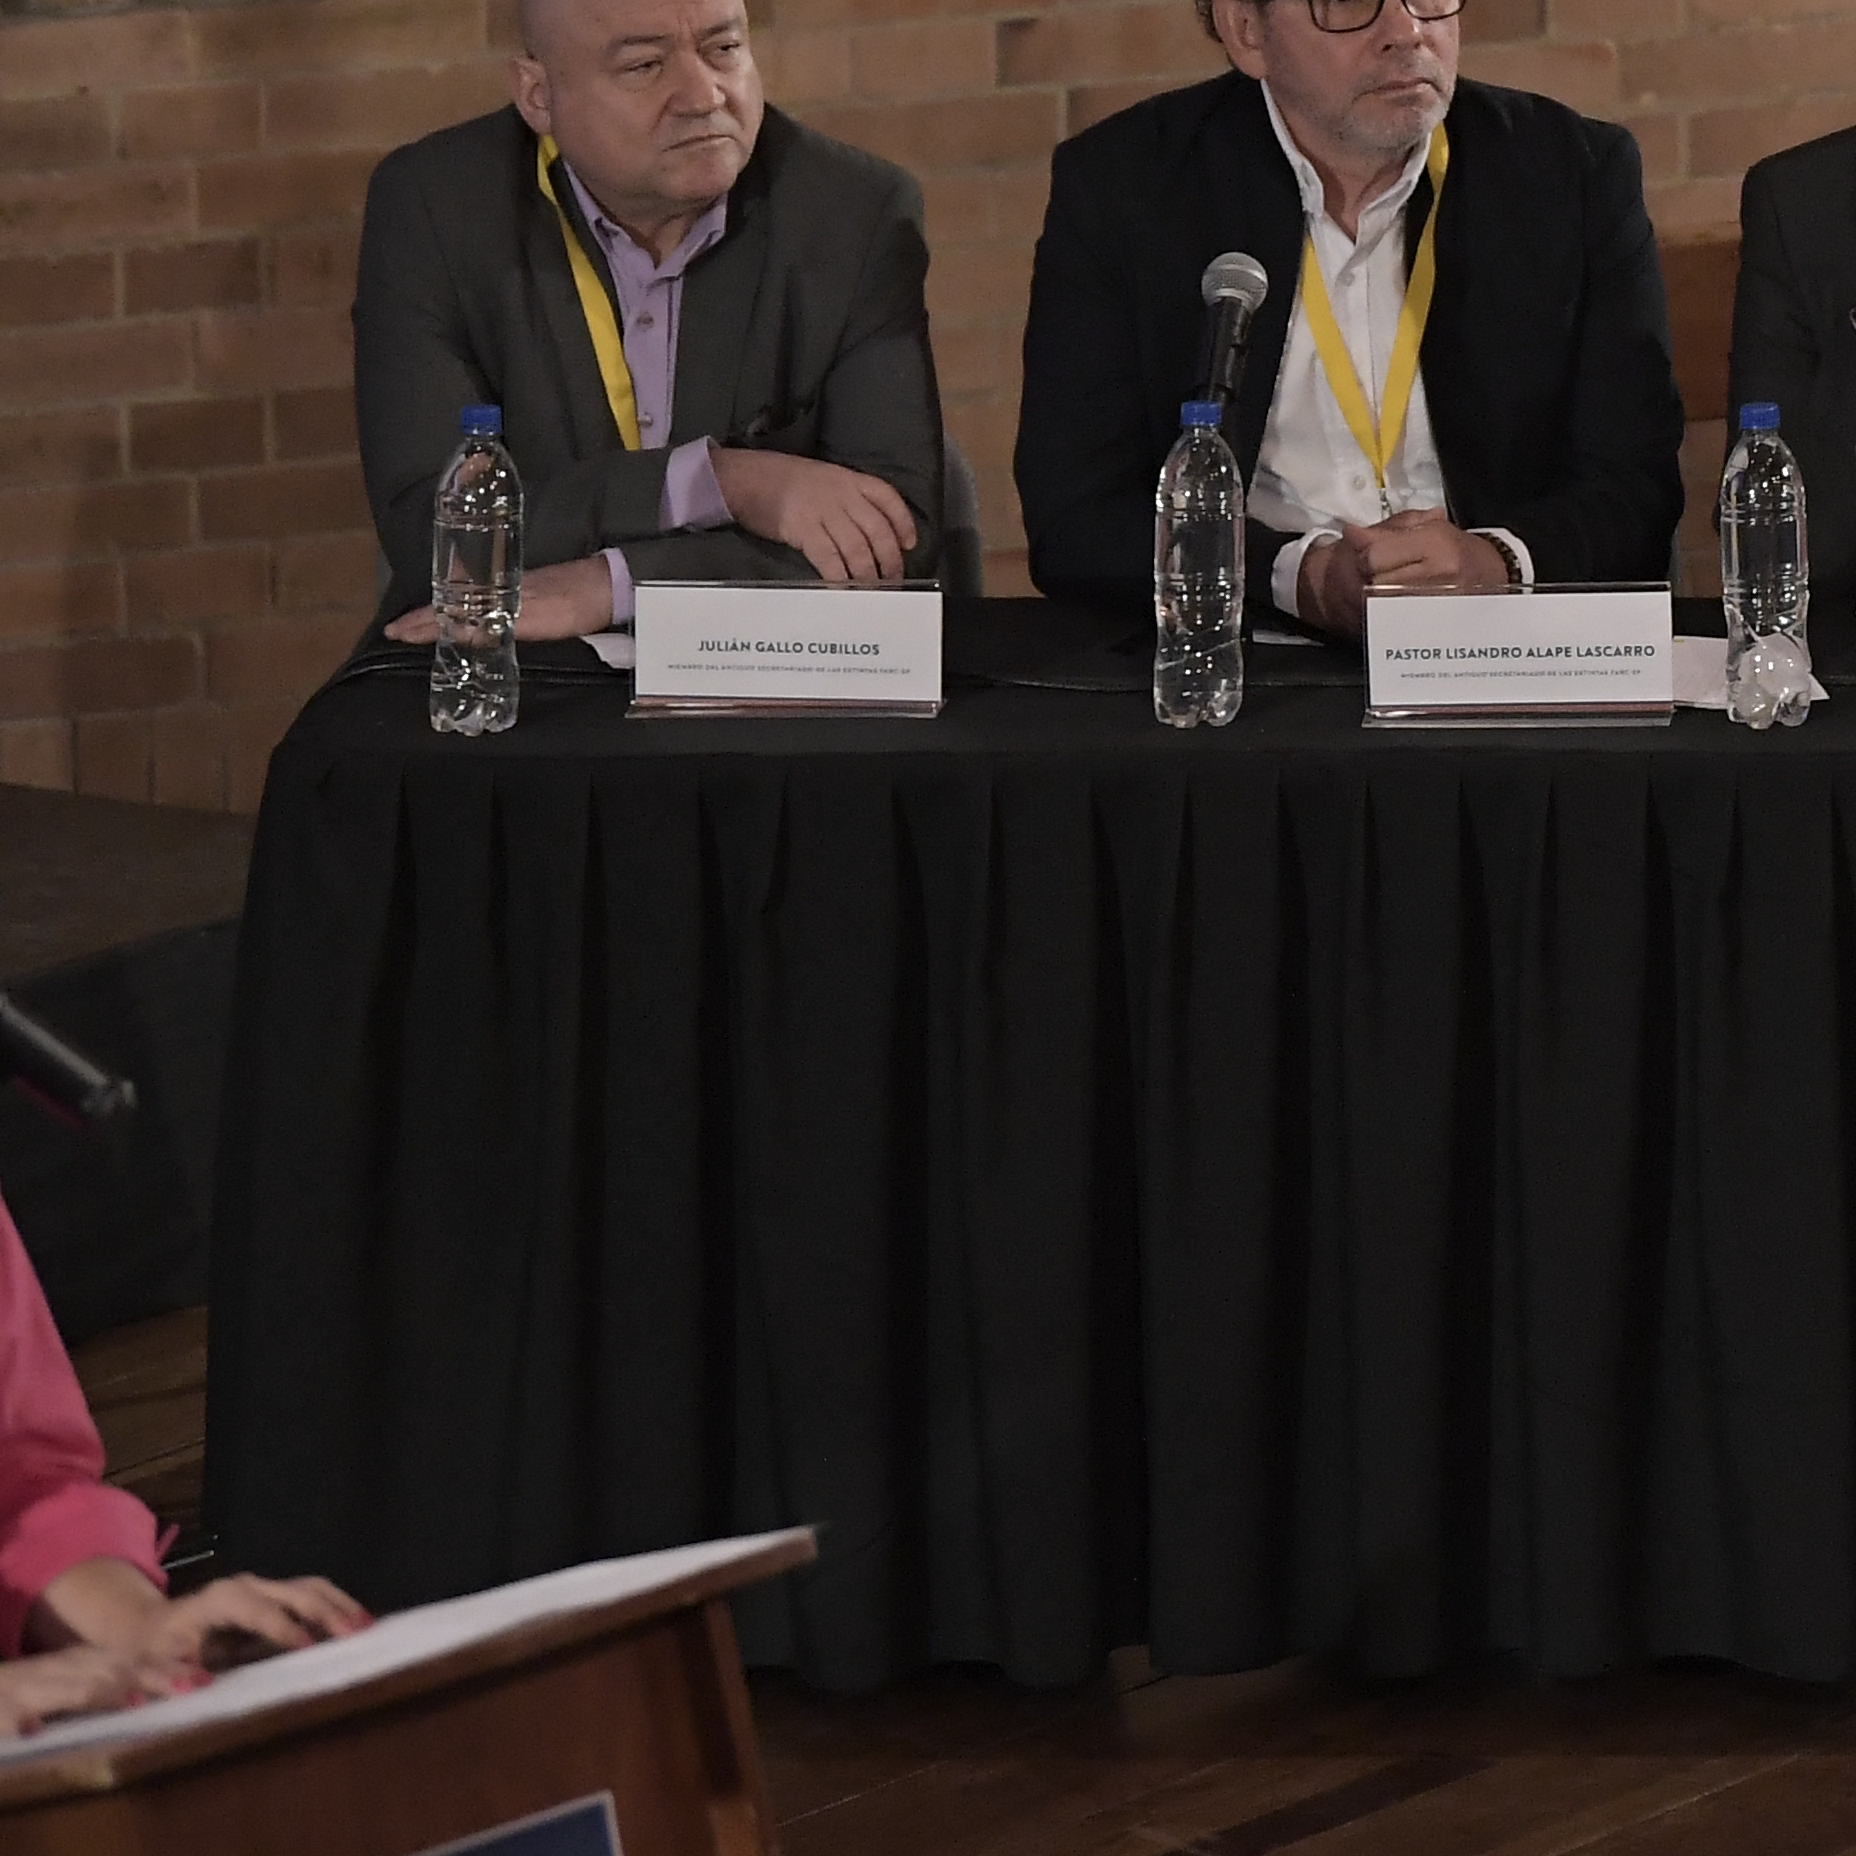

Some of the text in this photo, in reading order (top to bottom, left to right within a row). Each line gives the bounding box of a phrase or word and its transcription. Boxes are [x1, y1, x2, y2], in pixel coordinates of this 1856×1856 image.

[698, 638, 879, 655] JULIÁN GALLO CUBILLOS
[1386, 645, 1655, 660] PASTOR LISANDRO ALAPE LASCARRO
